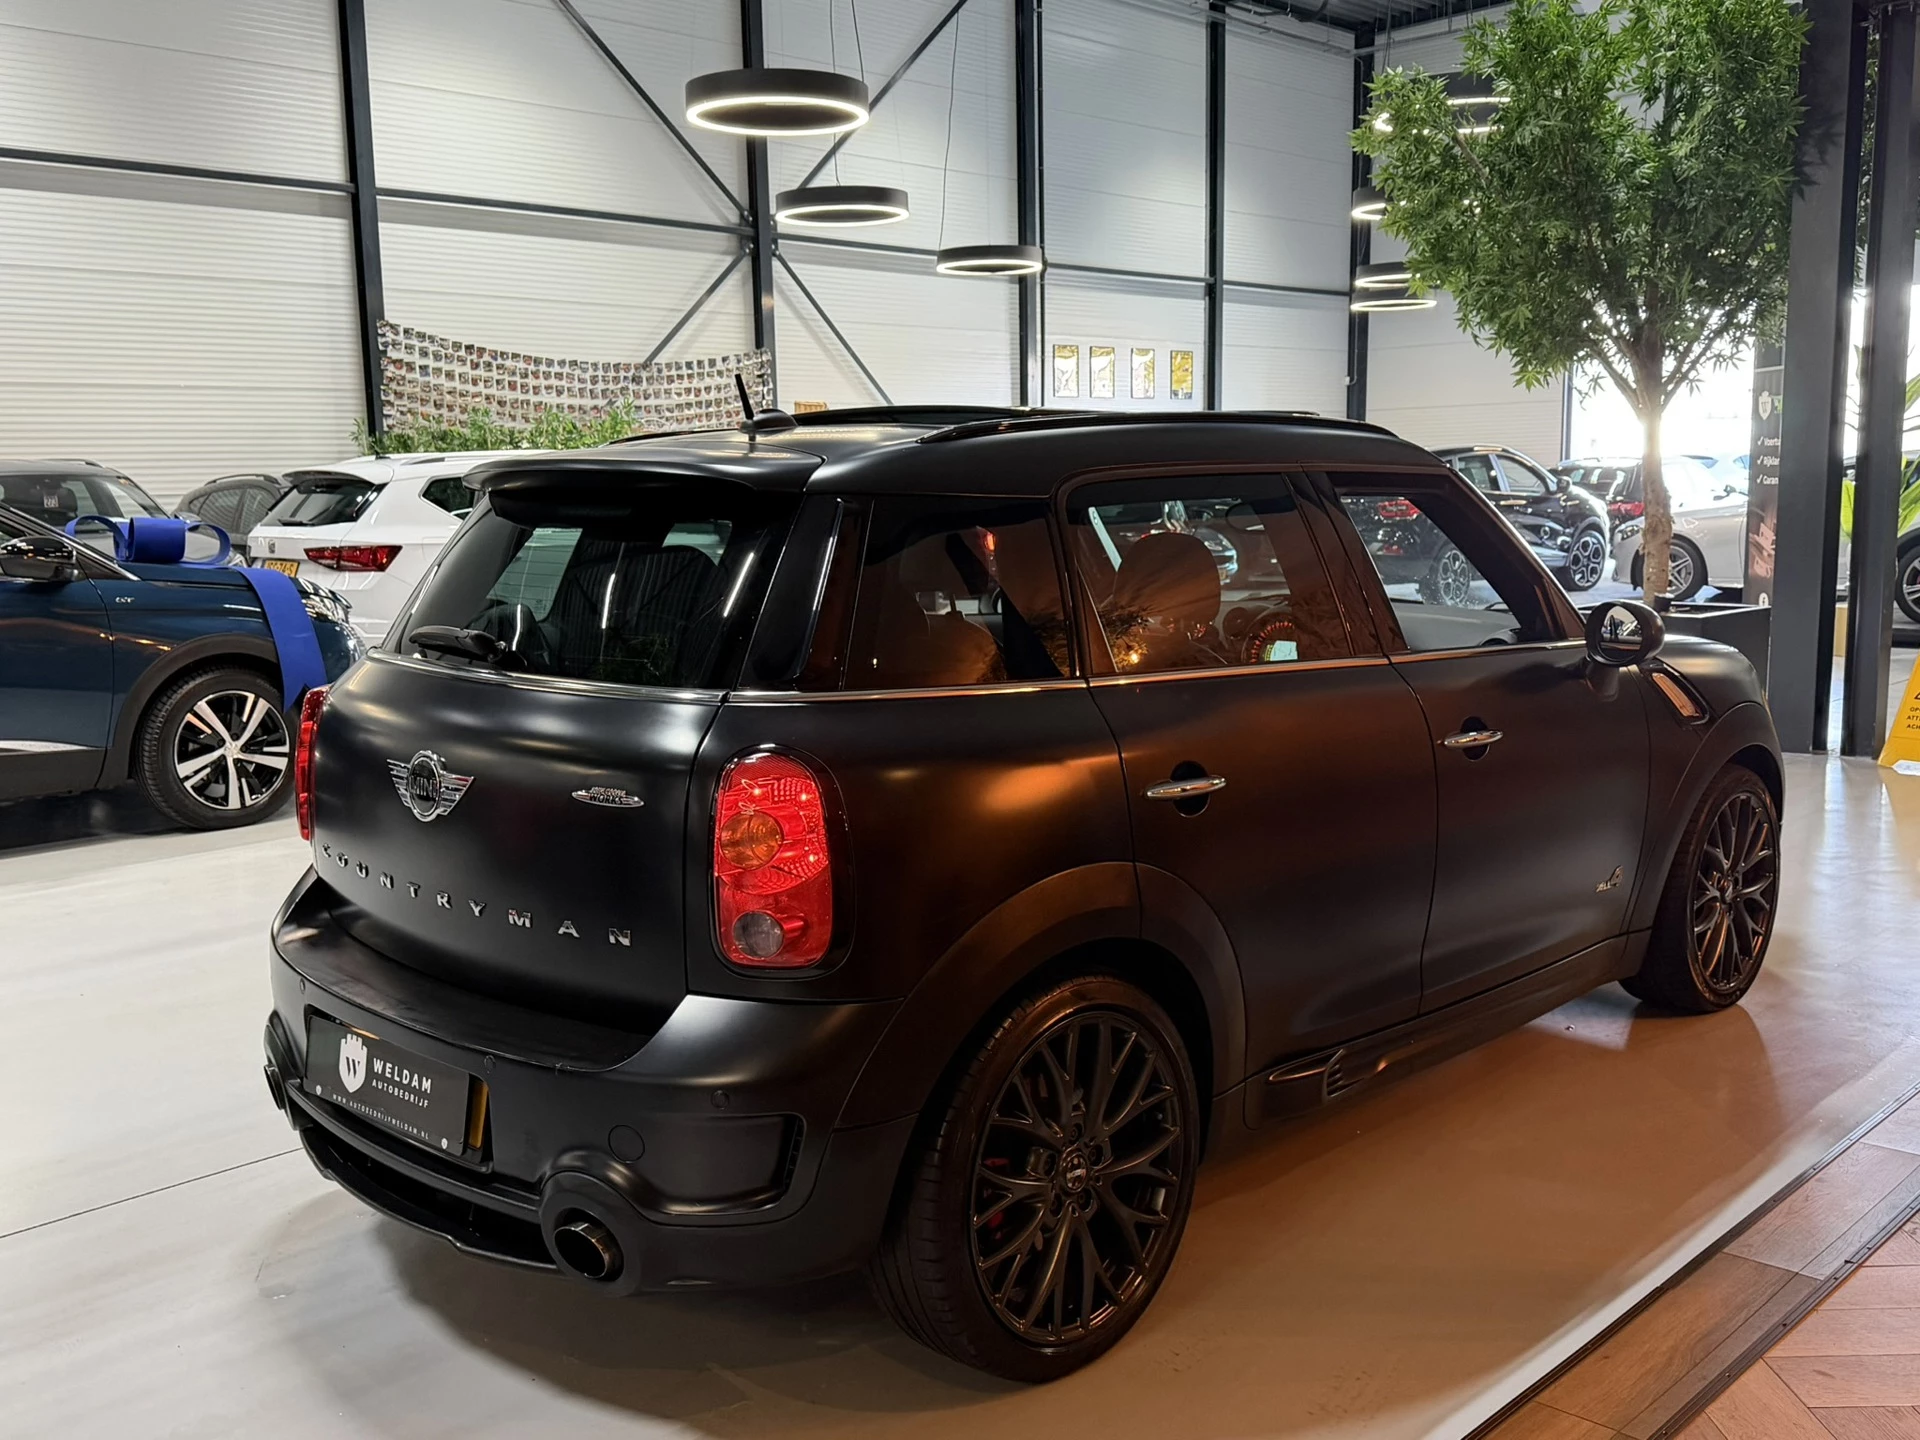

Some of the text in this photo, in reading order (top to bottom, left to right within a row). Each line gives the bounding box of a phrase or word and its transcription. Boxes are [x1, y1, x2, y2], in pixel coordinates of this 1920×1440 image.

[409, 774, 438, 799] MINI
[590, 794, 623, 805] WORKS
[322, 842, 632, 947] COUNTRYMAN
[373, 1057, 432, 1094] WELDAM
[372, 1078, 429, 1109] AUTOBEDRIJF
[332, 1093, 429, 1140] WWW.AUTOBEDRIJFWELDAM.NL
